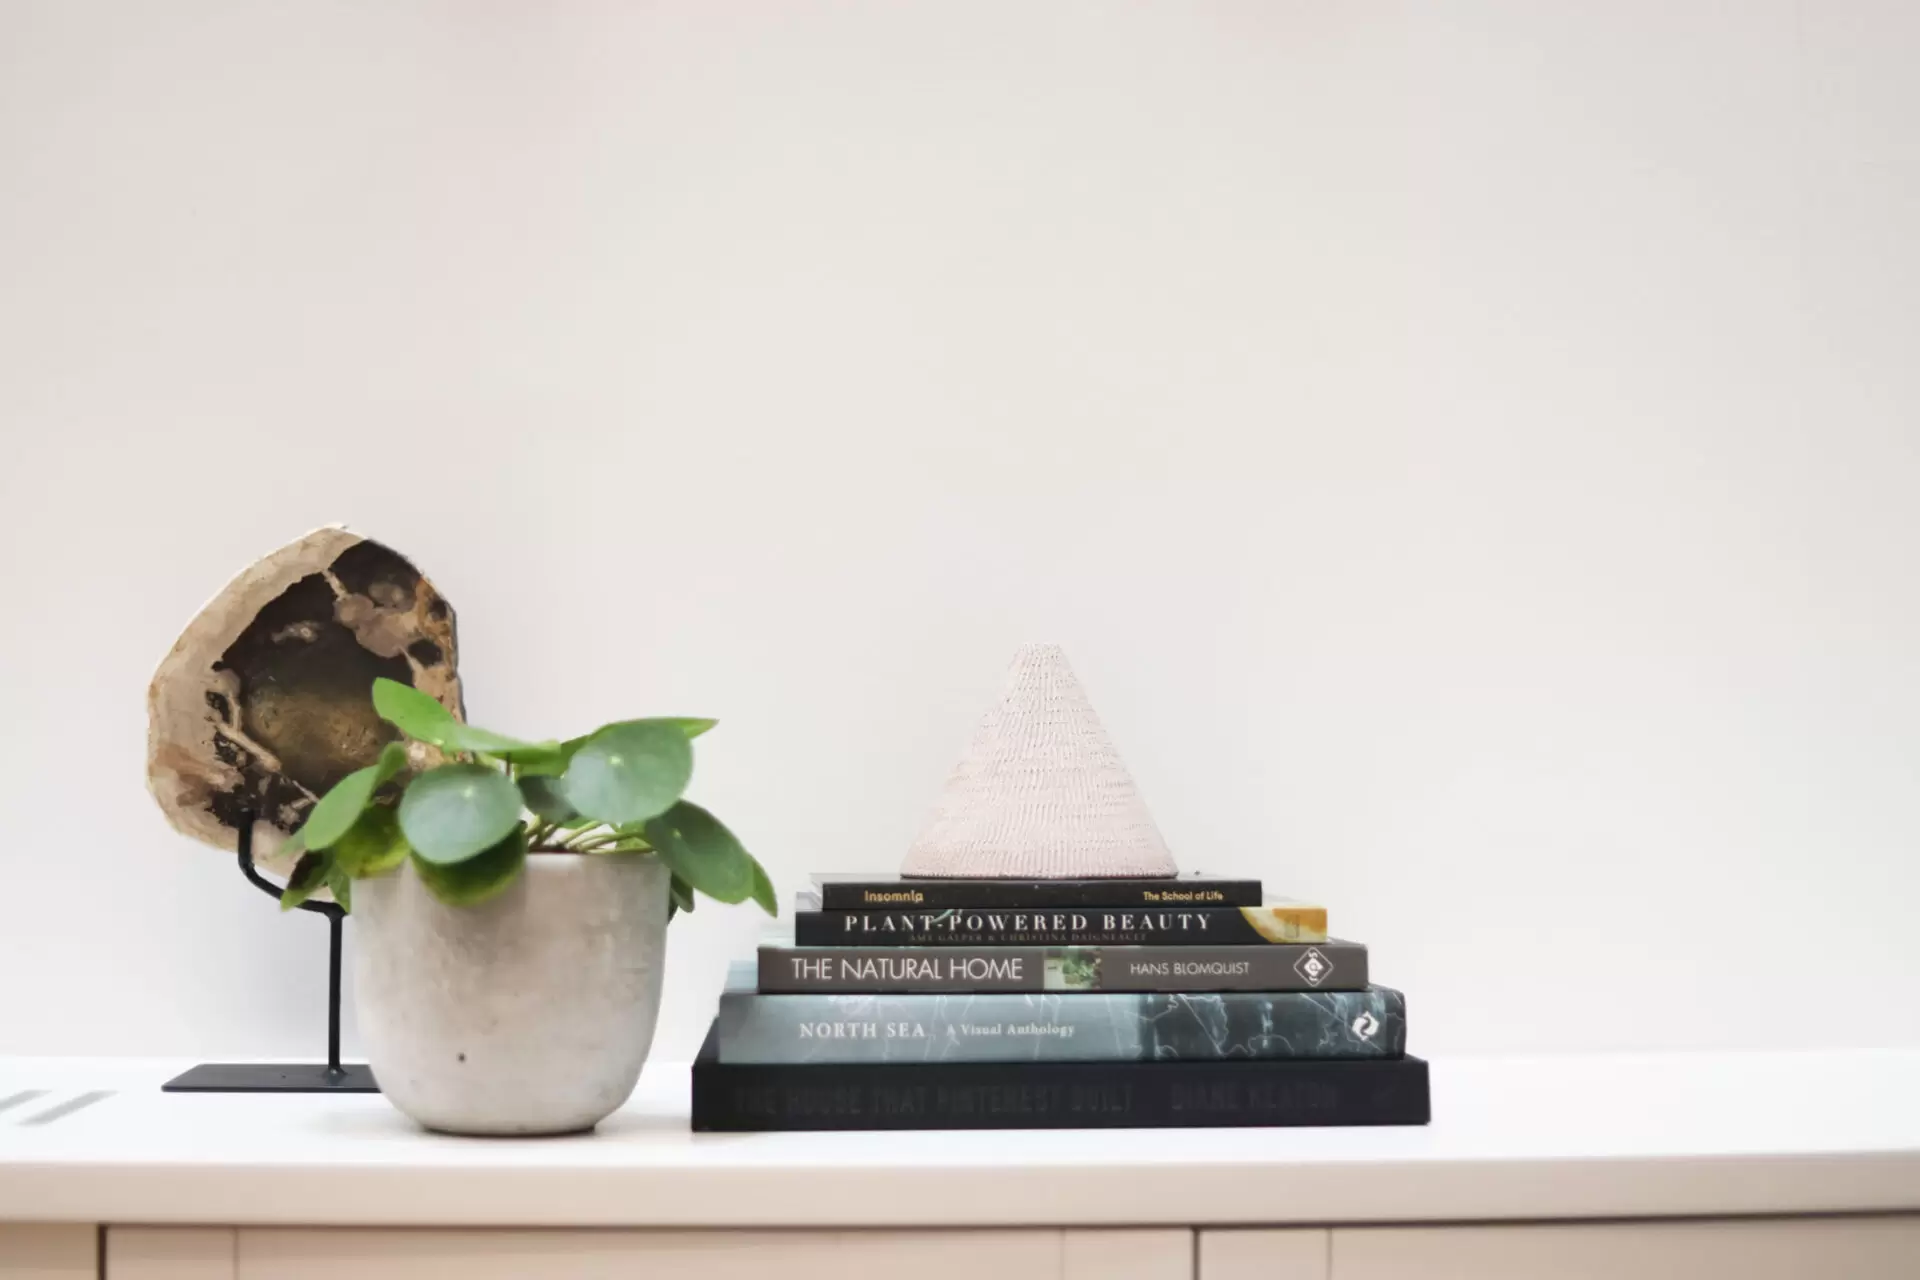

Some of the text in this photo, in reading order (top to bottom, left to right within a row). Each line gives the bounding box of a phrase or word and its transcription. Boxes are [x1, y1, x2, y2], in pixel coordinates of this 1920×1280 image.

[864, 890, 924, 903] Insomnia
[1143, 891, 1224, 901] The School of Life
[844, 913, 1212, 932] PLANT-POWERED BEAUTY
[1000, 933, 1067, 942] CHRISTINA
[792, 958, 1023, 980] THE NATURAL HOME
[1130, 961, 1251, 976] HANS BLOMQUIST
[800, 1022, 926, 1039] NORTH SEA
[946, 1022, 1076, 1039] A Visual Anthology
